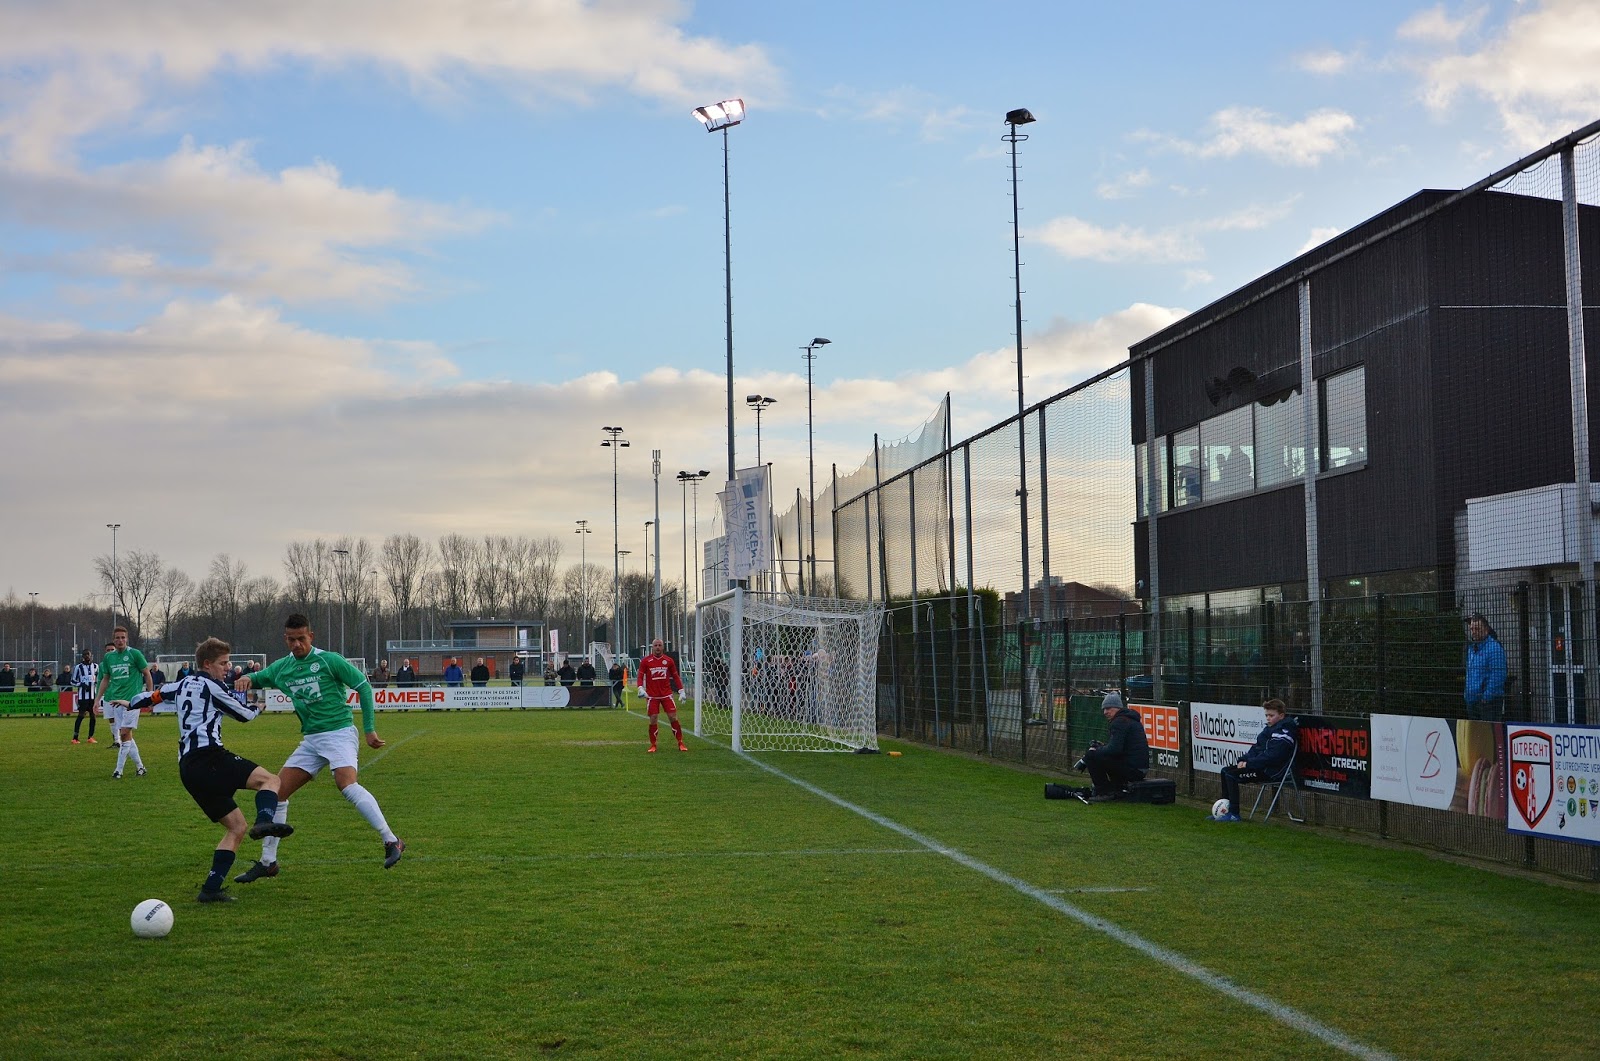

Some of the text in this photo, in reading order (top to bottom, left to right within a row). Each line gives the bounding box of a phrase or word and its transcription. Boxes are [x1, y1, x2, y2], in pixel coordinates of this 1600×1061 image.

[181, 699, 193, 730] 2
[1199, 711, 1236, 738] Madico
[1144, 713, 1178, 743] EES
[1157, 750, 1179, 768] reclame
[1193, 744, 1247, 767] MATTENKON
[1513, 742, 1549, 758] UTRECHT
[1331, 756, 1367, 771] UTRECHT
[1555, 761, 1561, 770] DE
[1562, 761, 1590, 773] UTRECHTSE
